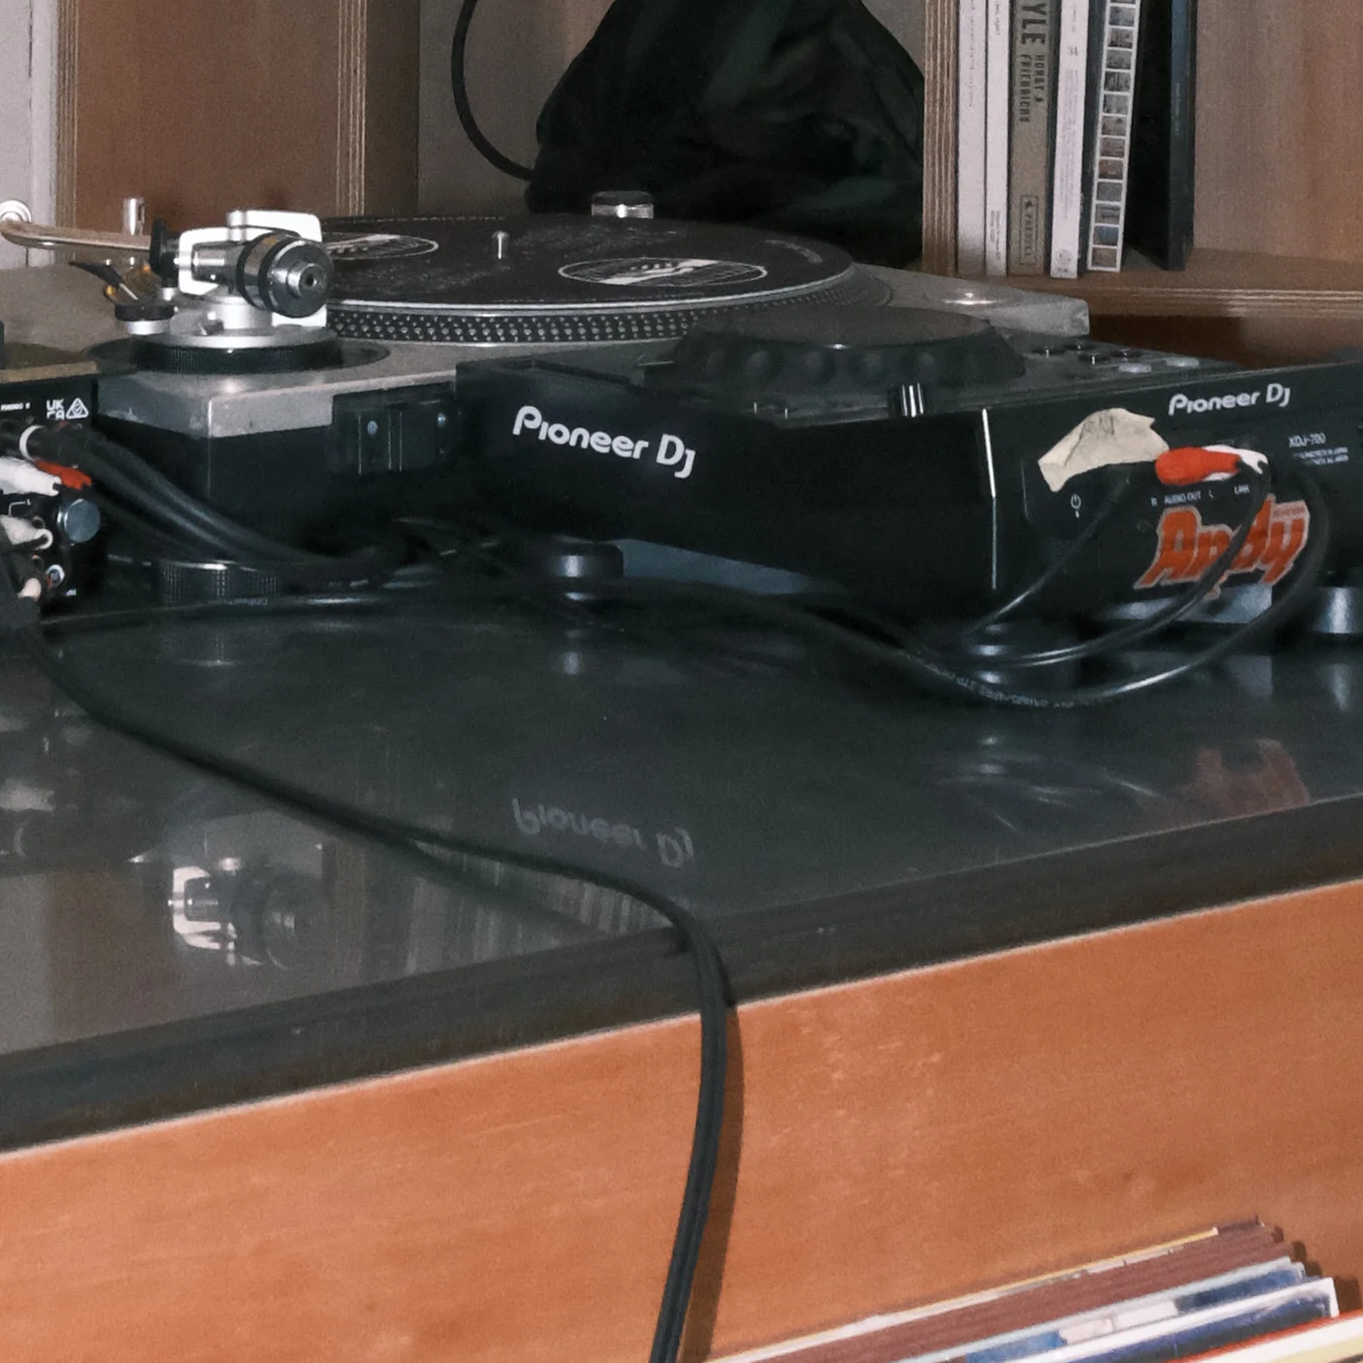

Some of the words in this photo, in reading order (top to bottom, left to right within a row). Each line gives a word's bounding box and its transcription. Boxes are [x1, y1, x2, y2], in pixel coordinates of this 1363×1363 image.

[46, 399, 65, 411] UK
[1168, 391, 1261, 416] Pioneer
[512, 404, 650, 462] Pioneer
[1164, 493, 1186, 505] AUDIO
[1186, 490, 1201, 501] OUT
[1137, 498, 1308, 590] Andy
